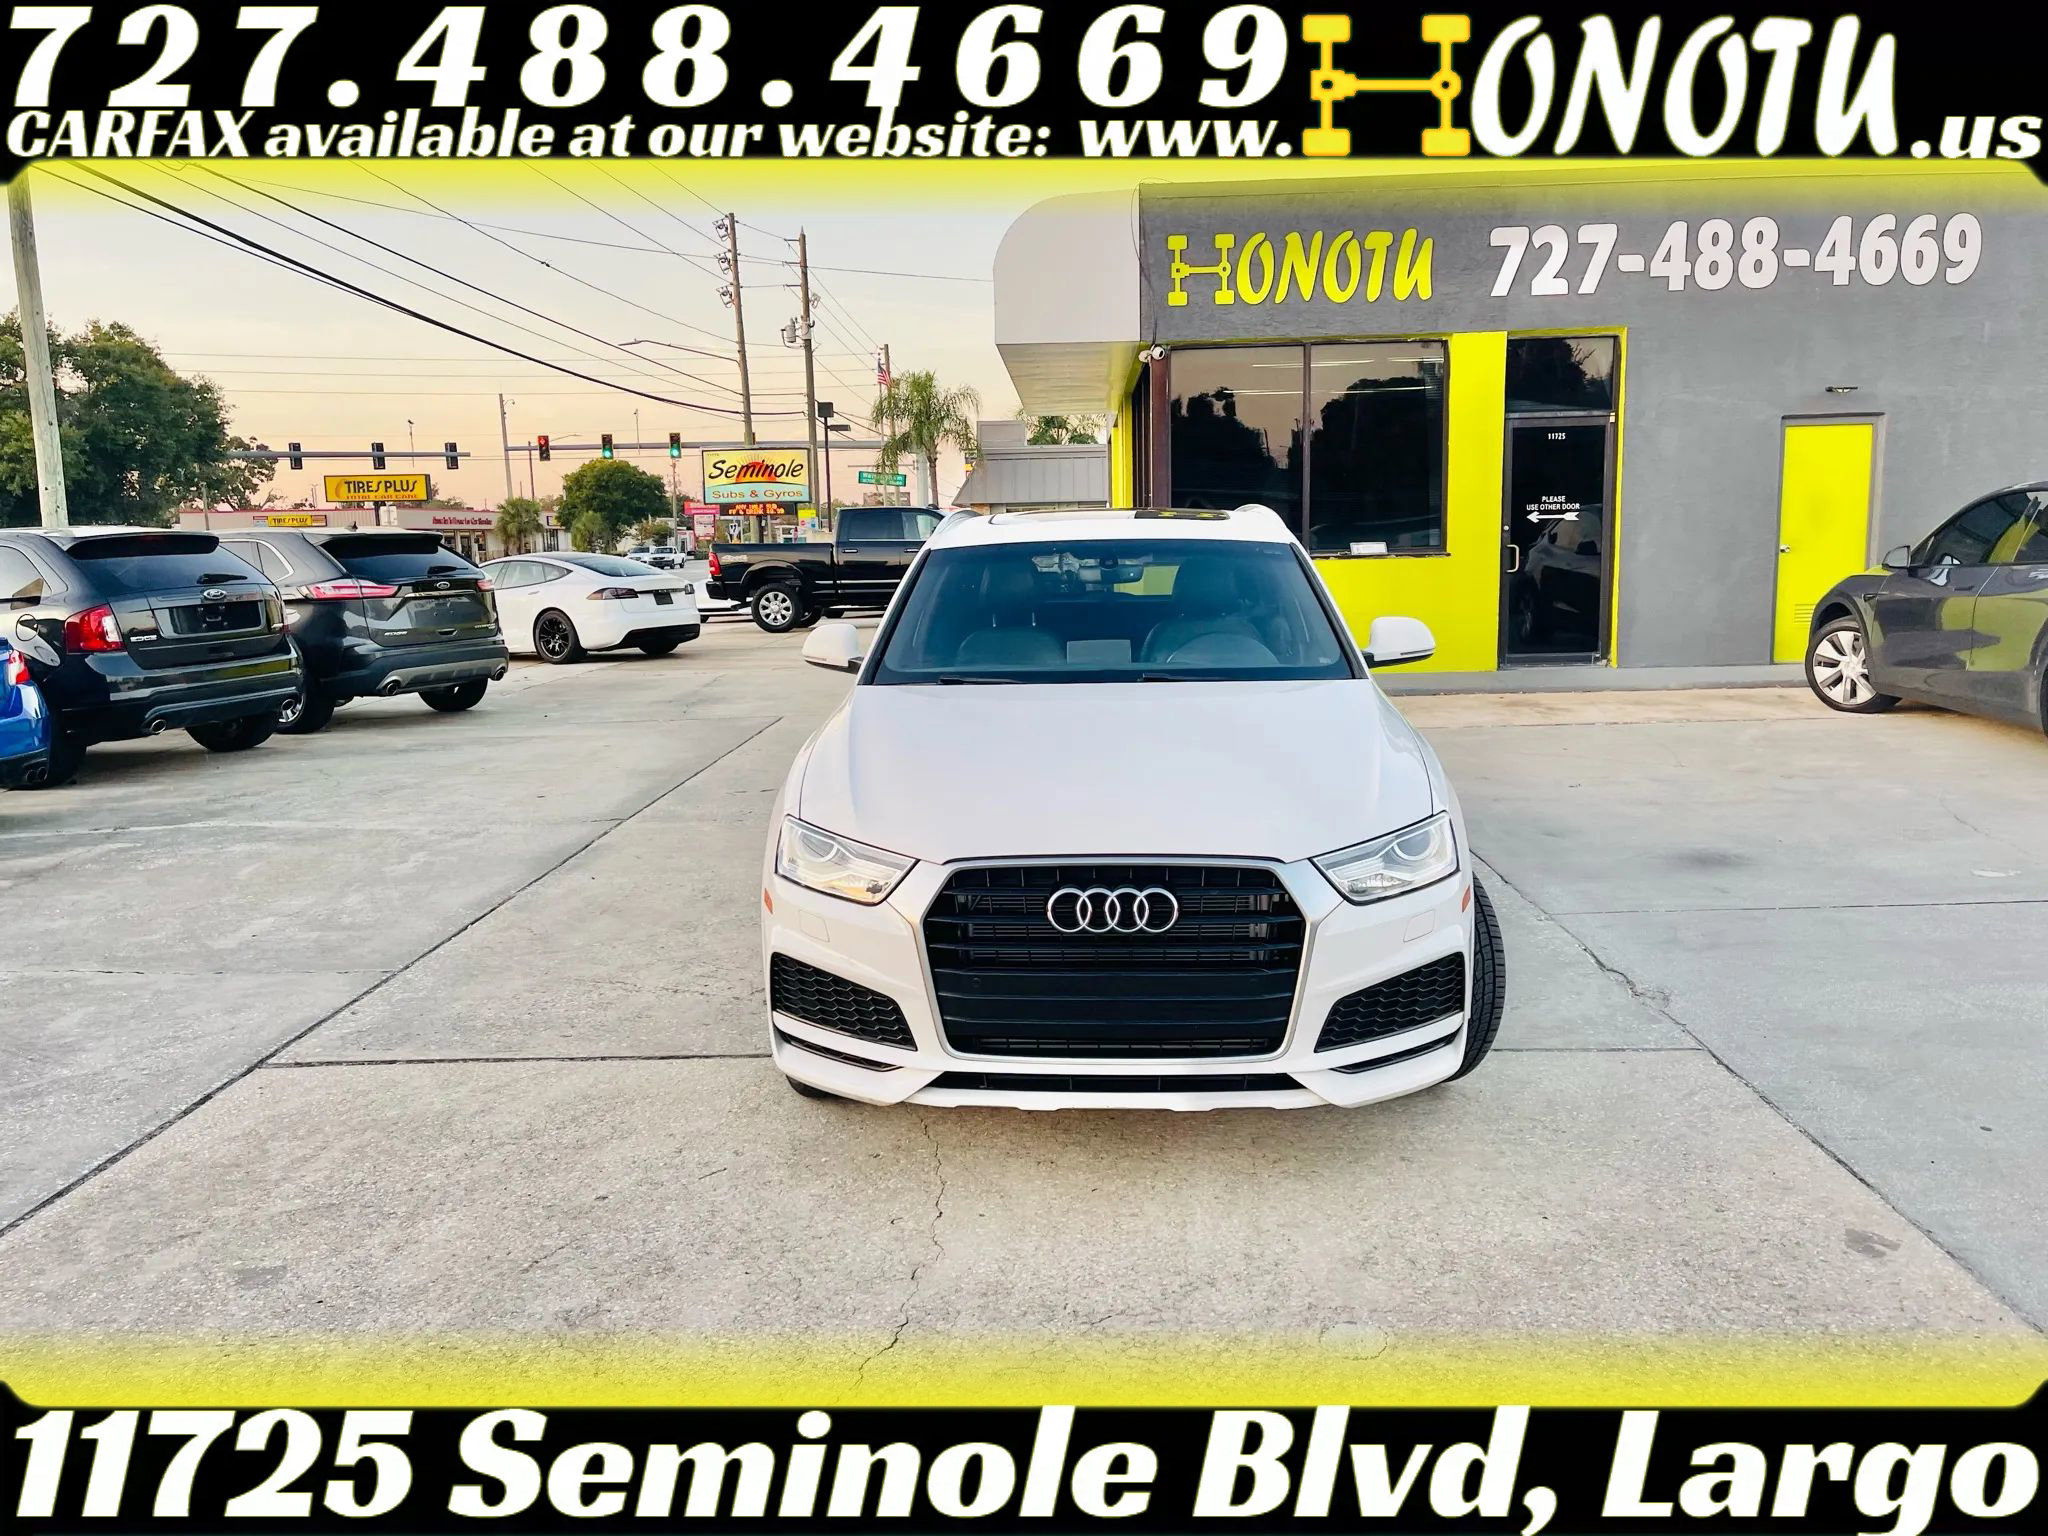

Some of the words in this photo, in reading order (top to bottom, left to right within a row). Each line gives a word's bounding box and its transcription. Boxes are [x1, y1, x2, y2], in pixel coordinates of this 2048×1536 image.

[1490, 212, 1982, 297] 727-488-4669
[708, 458, 804, 479] Seminole
[344, 480, 381, 493] TIRES
[384, 480, 418, 493] PLUS
[712, 490, 745, 498] Subs
[750, 490, 759, 498] &
[763, 489, 803, 500] Gyros
[1541, 495, 1566, 503] PLEASE
